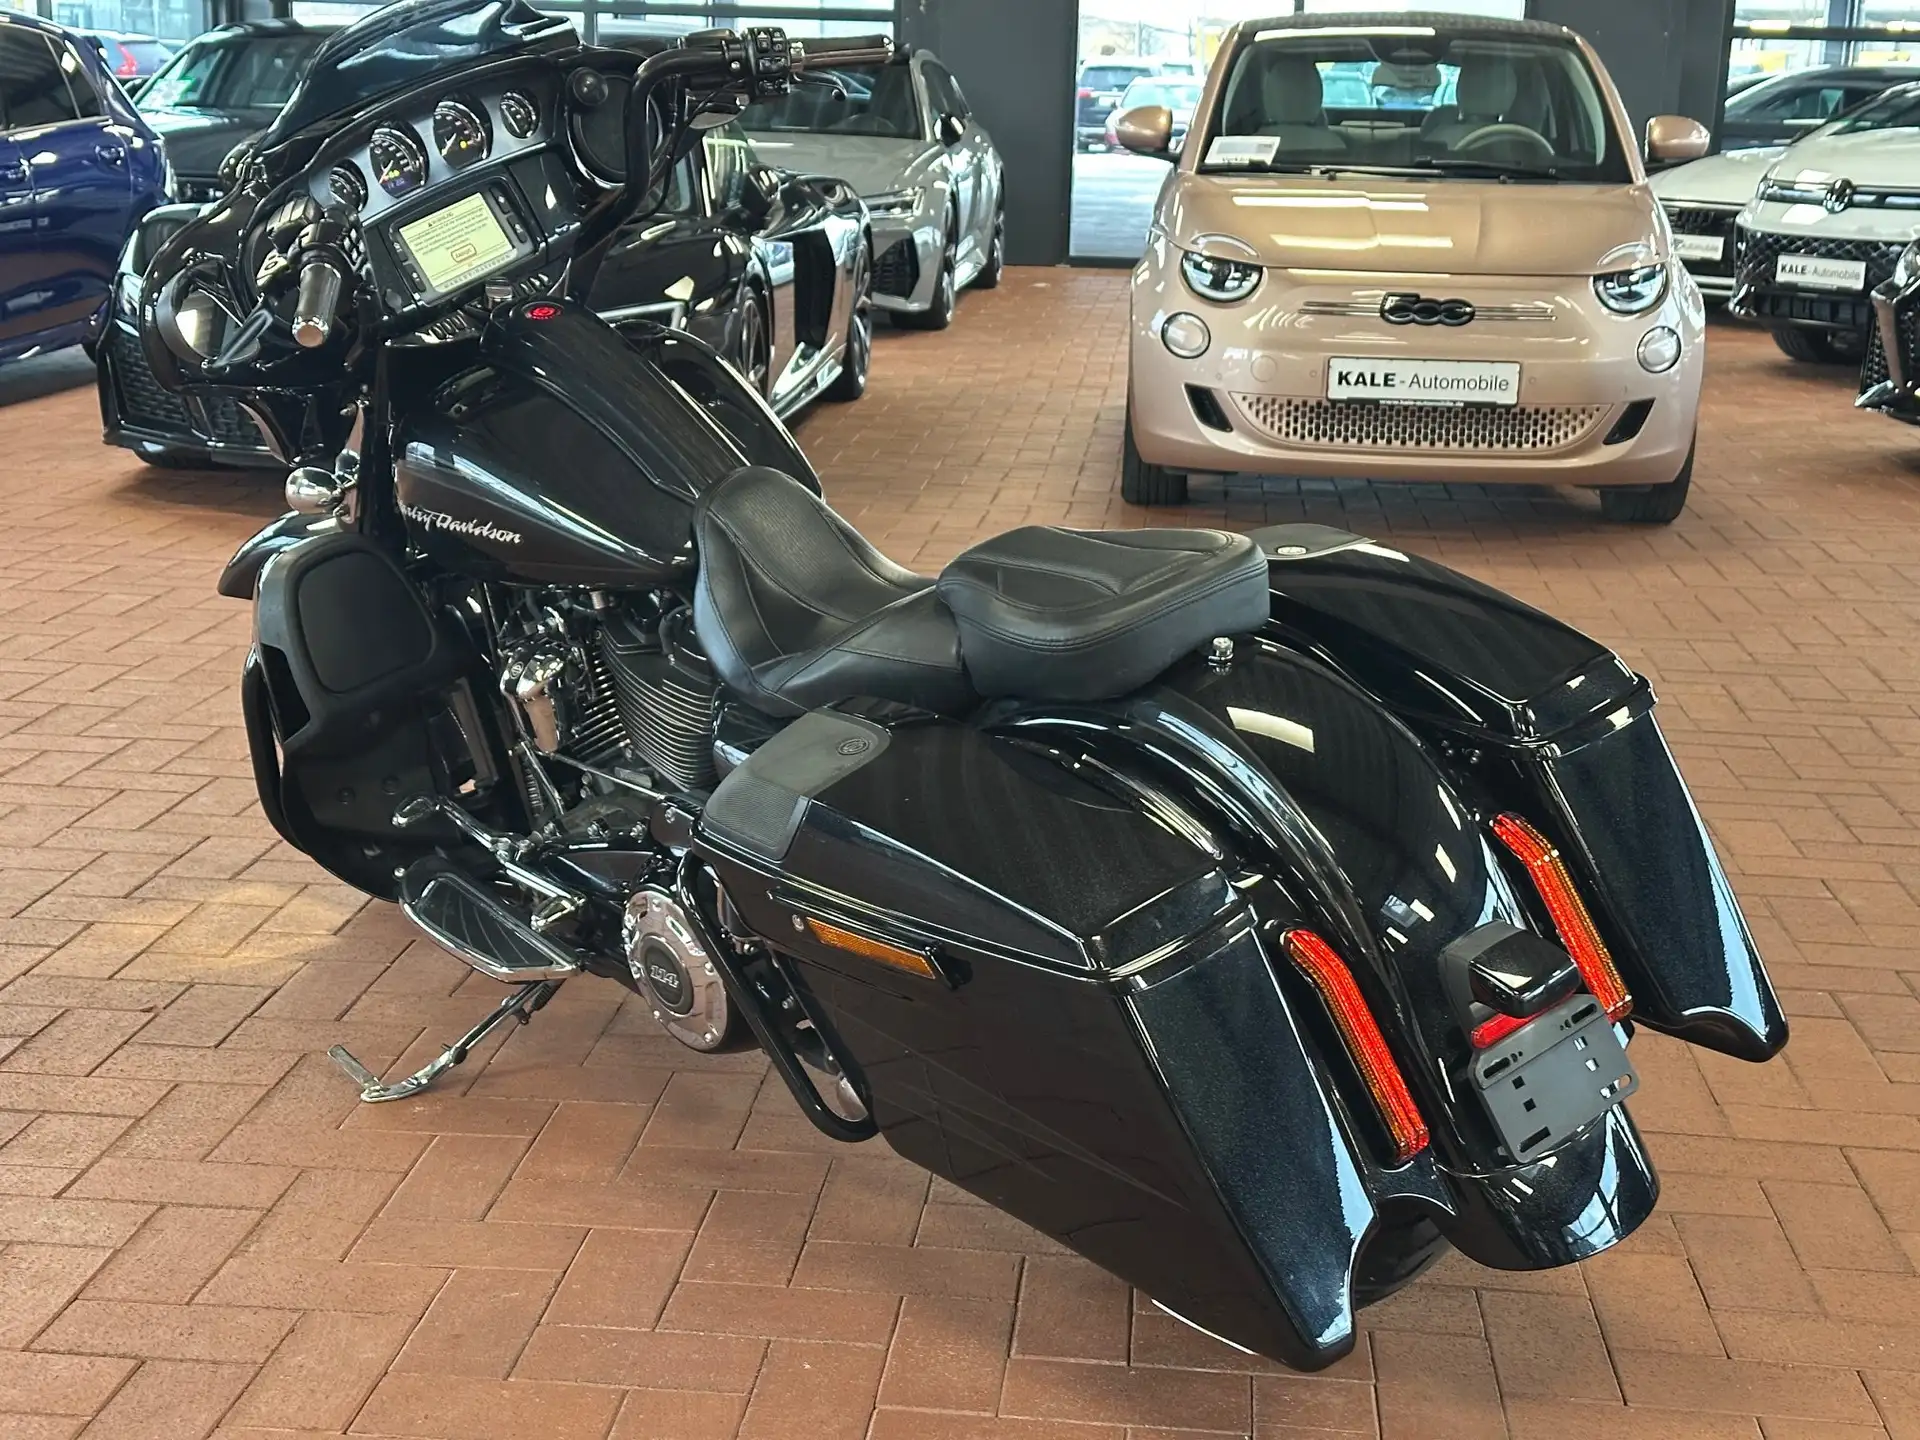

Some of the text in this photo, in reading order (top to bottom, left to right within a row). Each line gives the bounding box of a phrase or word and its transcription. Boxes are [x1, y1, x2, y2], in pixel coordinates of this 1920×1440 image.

[1781, 263, 1807, 276] KALE
[1380, 291, 1476, 326] 500
[1337, 371, 1396, 388] KALE
[1408, 374, 1509, 391] Automobile
[400, 503, 521, 543] arley-Davidson
[651, 965, 679, 988] 114
